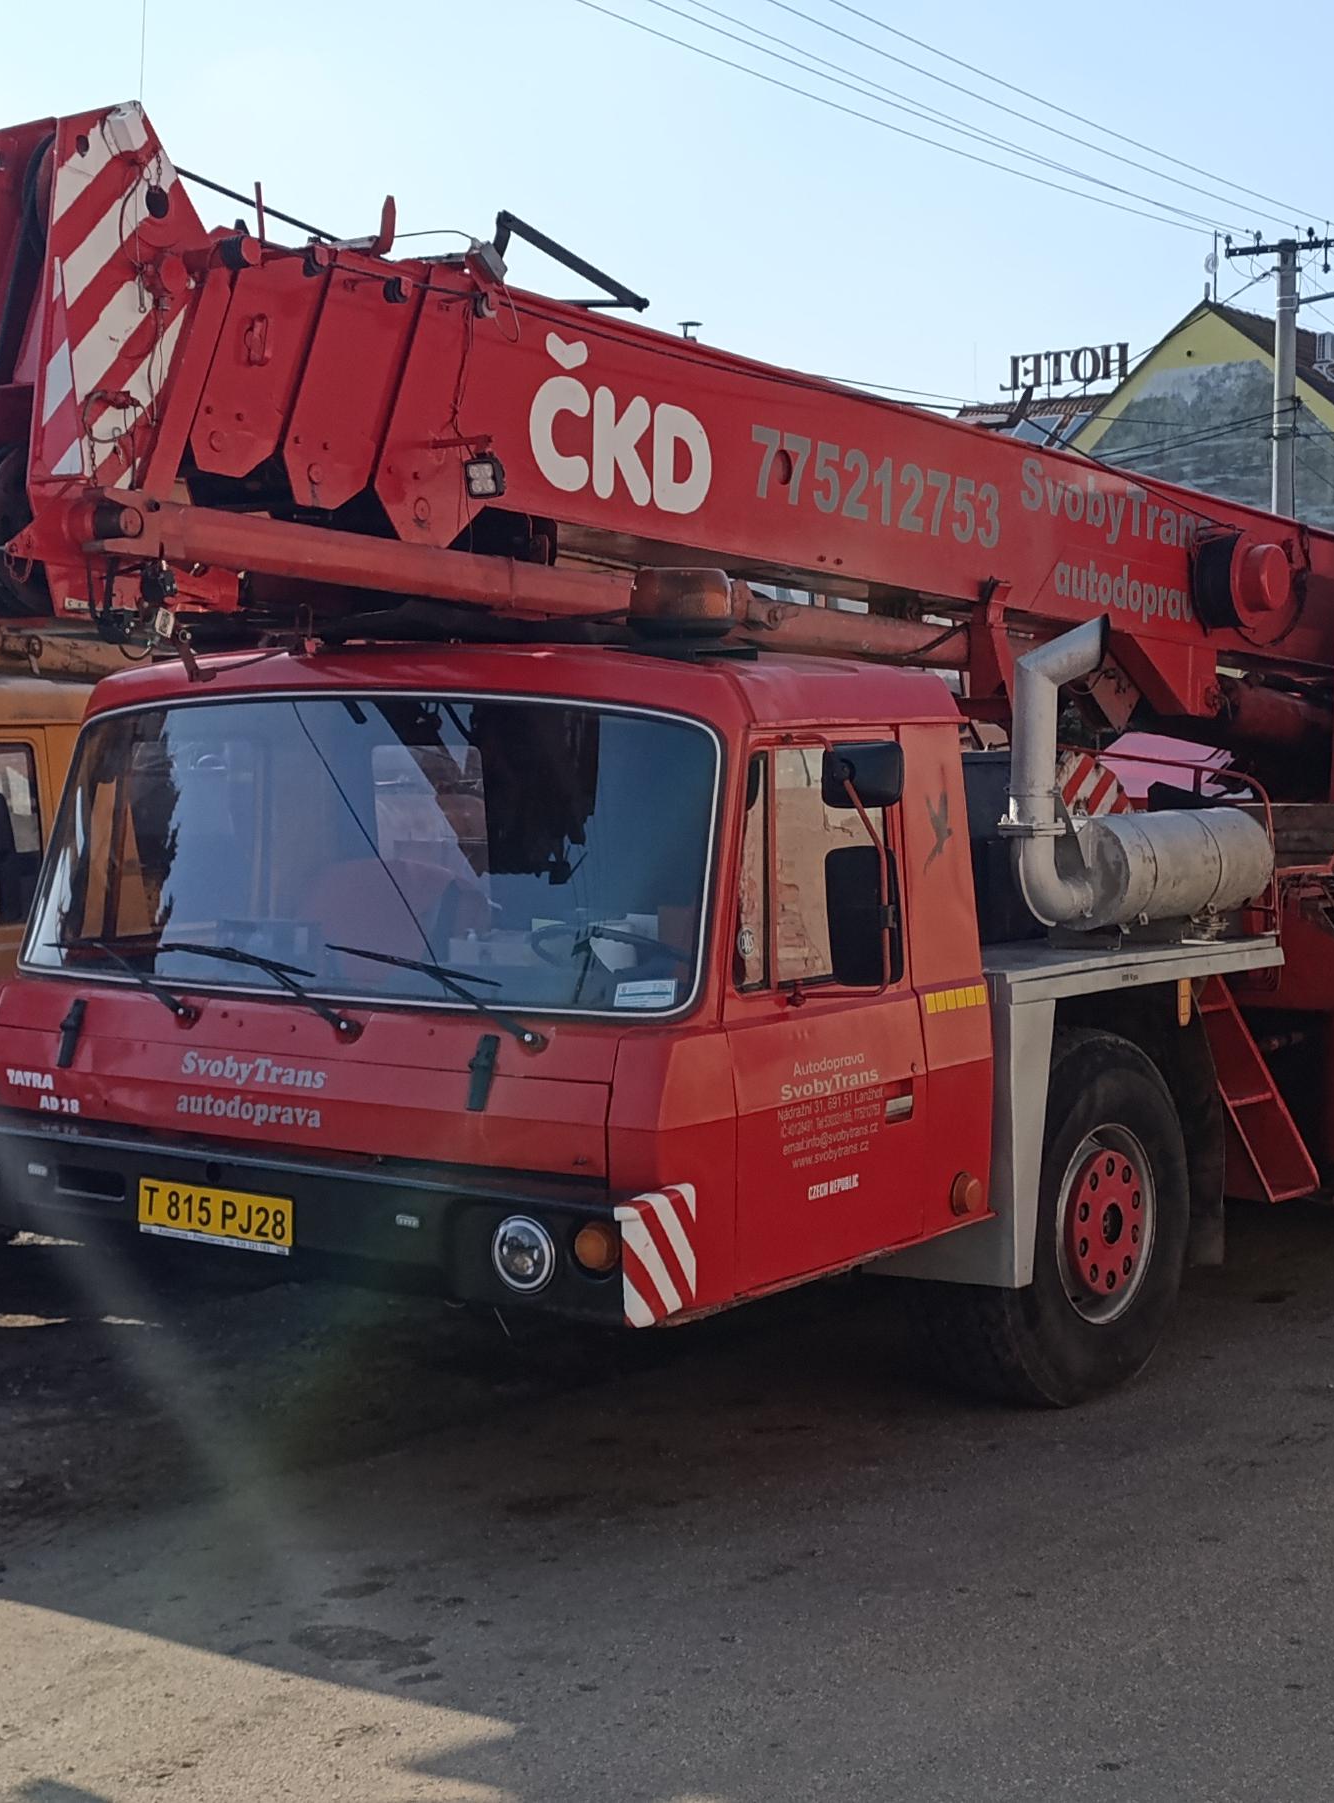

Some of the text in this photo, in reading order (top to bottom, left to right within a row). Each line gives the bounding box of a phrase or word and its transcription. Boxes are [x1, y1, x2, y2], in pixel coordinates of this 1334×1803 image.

[529, 332, 712, 515] ČKD
[751, 424, 1000, 549] 775212753
[1054, 560, 1194, 624] autodoprav
[6, 1068, 54, 1091] TATRA
[181, 1050, 327, 1089] SvobyTrans
[793, 1053, 865, 1078] Autodoprava
[781, 1068, 880, 1101] SvobyTrans
[39, 1094, 60, 1111] AD
[176, 1094, 322, 1129] autodoprava
[808, 1173, 860, 1201] CZECH REPUBLIC
[143, 1185, 160, 1217] T
[166, 1190, 212, 1227] 815
[221, 1200, 286, 1241] PJ28
